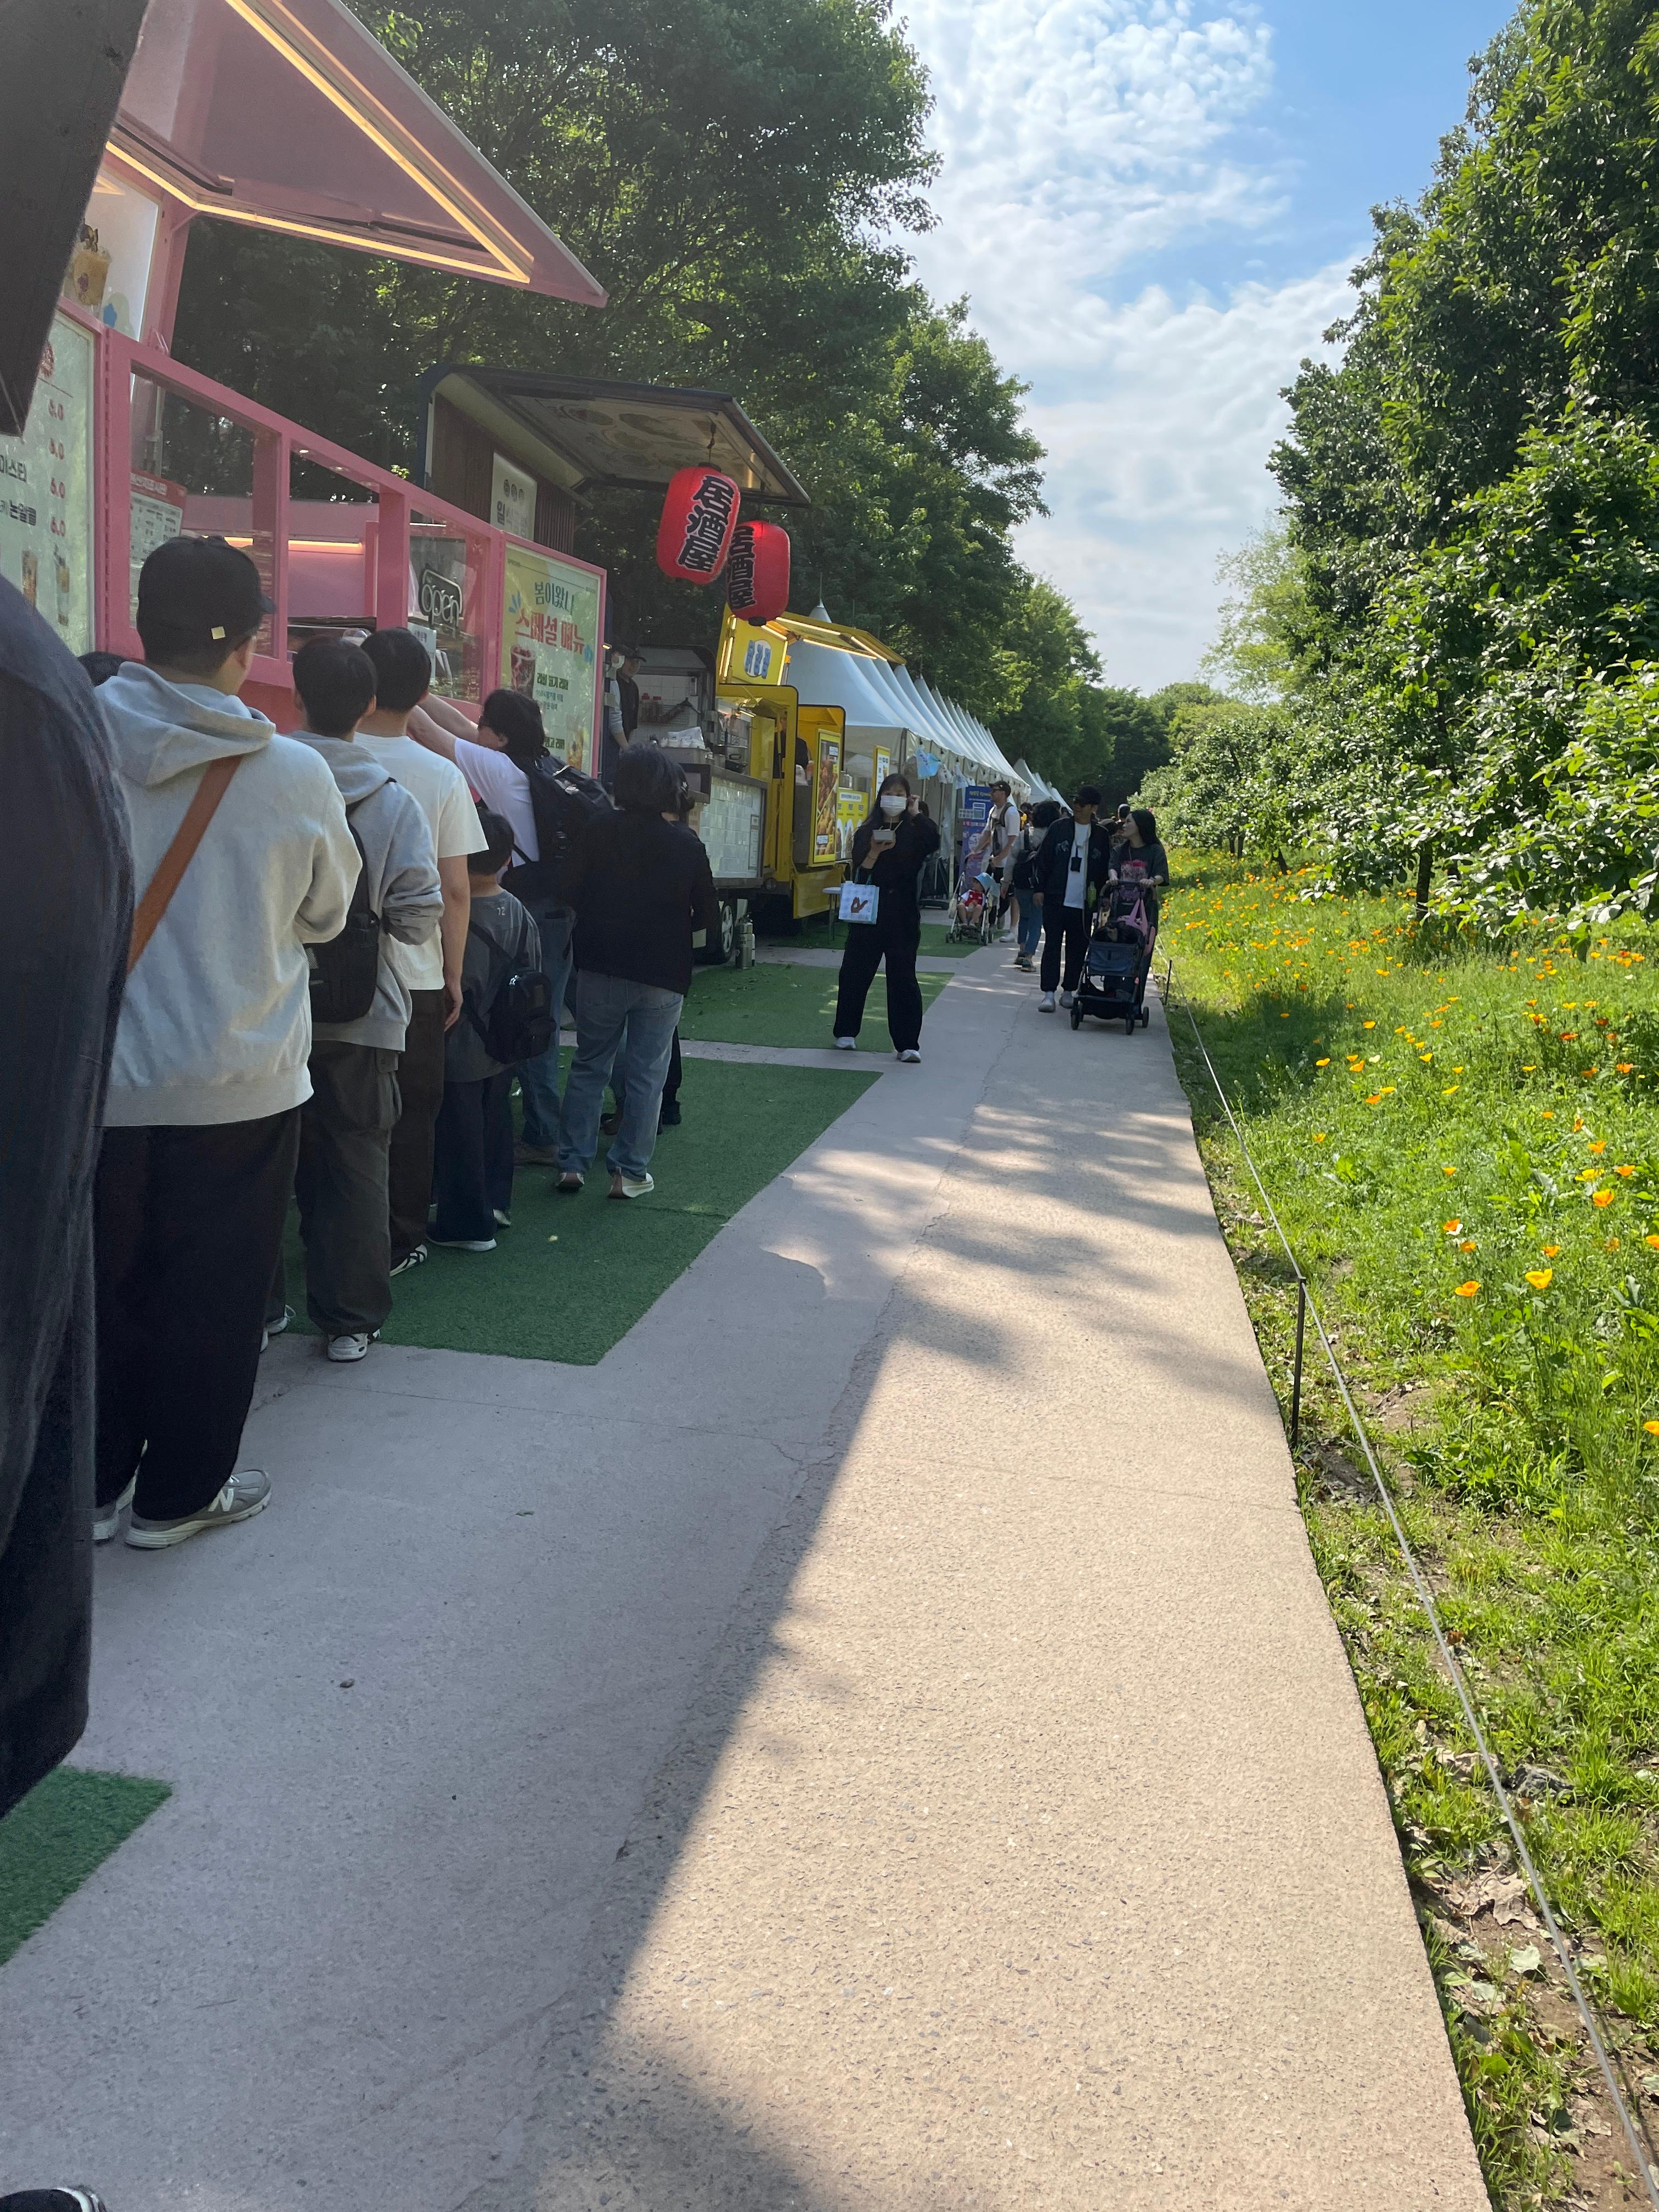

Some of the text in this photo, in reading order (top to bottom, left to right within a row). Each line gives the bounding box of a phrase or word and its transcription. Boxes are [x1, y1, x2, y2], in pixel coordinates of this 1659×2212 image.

[678, 475, 734, 572] 居酒屋
[515, 608, 585, 654] 스페셜 메뉴
